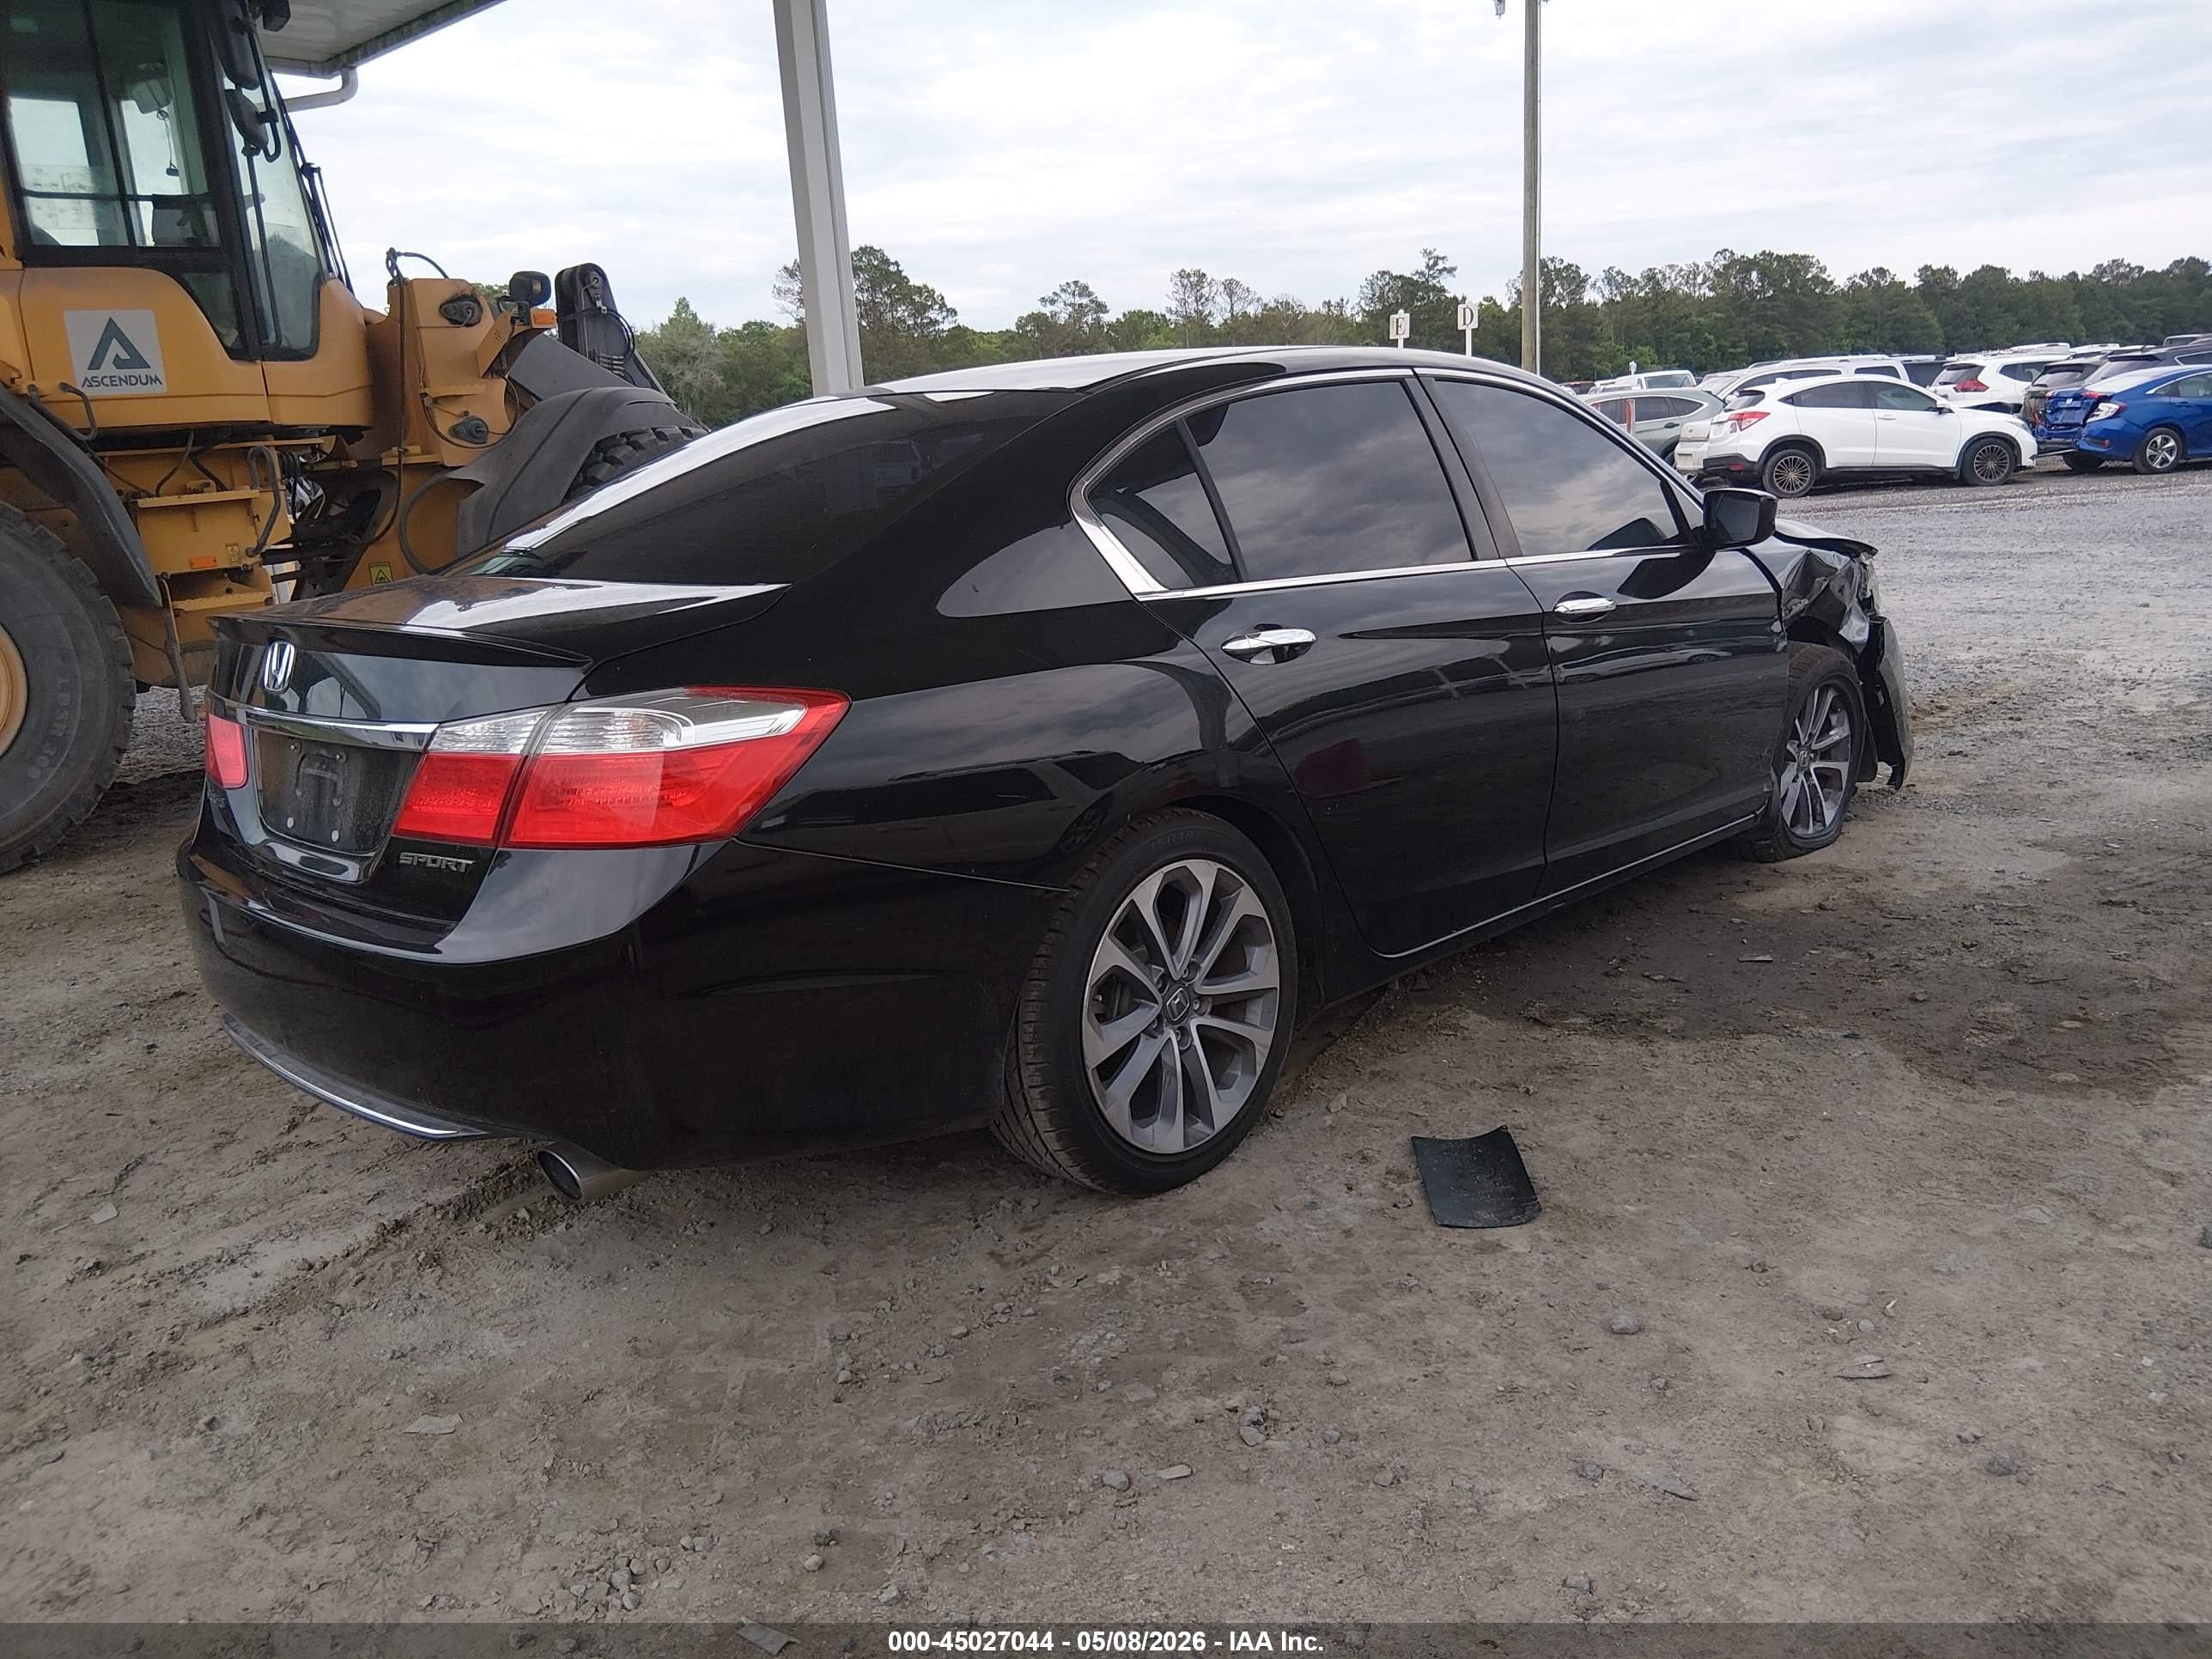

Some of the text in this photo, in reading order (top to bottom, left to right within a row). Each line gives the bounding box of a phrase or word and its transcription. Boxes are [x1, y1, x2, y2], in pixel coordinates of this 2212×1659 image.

[1462, 307, 1474, 326] D
[1395, 317, 1406, 336] E
[82, 374, 163, 388] ASCENDUM
[398, 852, 477, 873] SPORT
